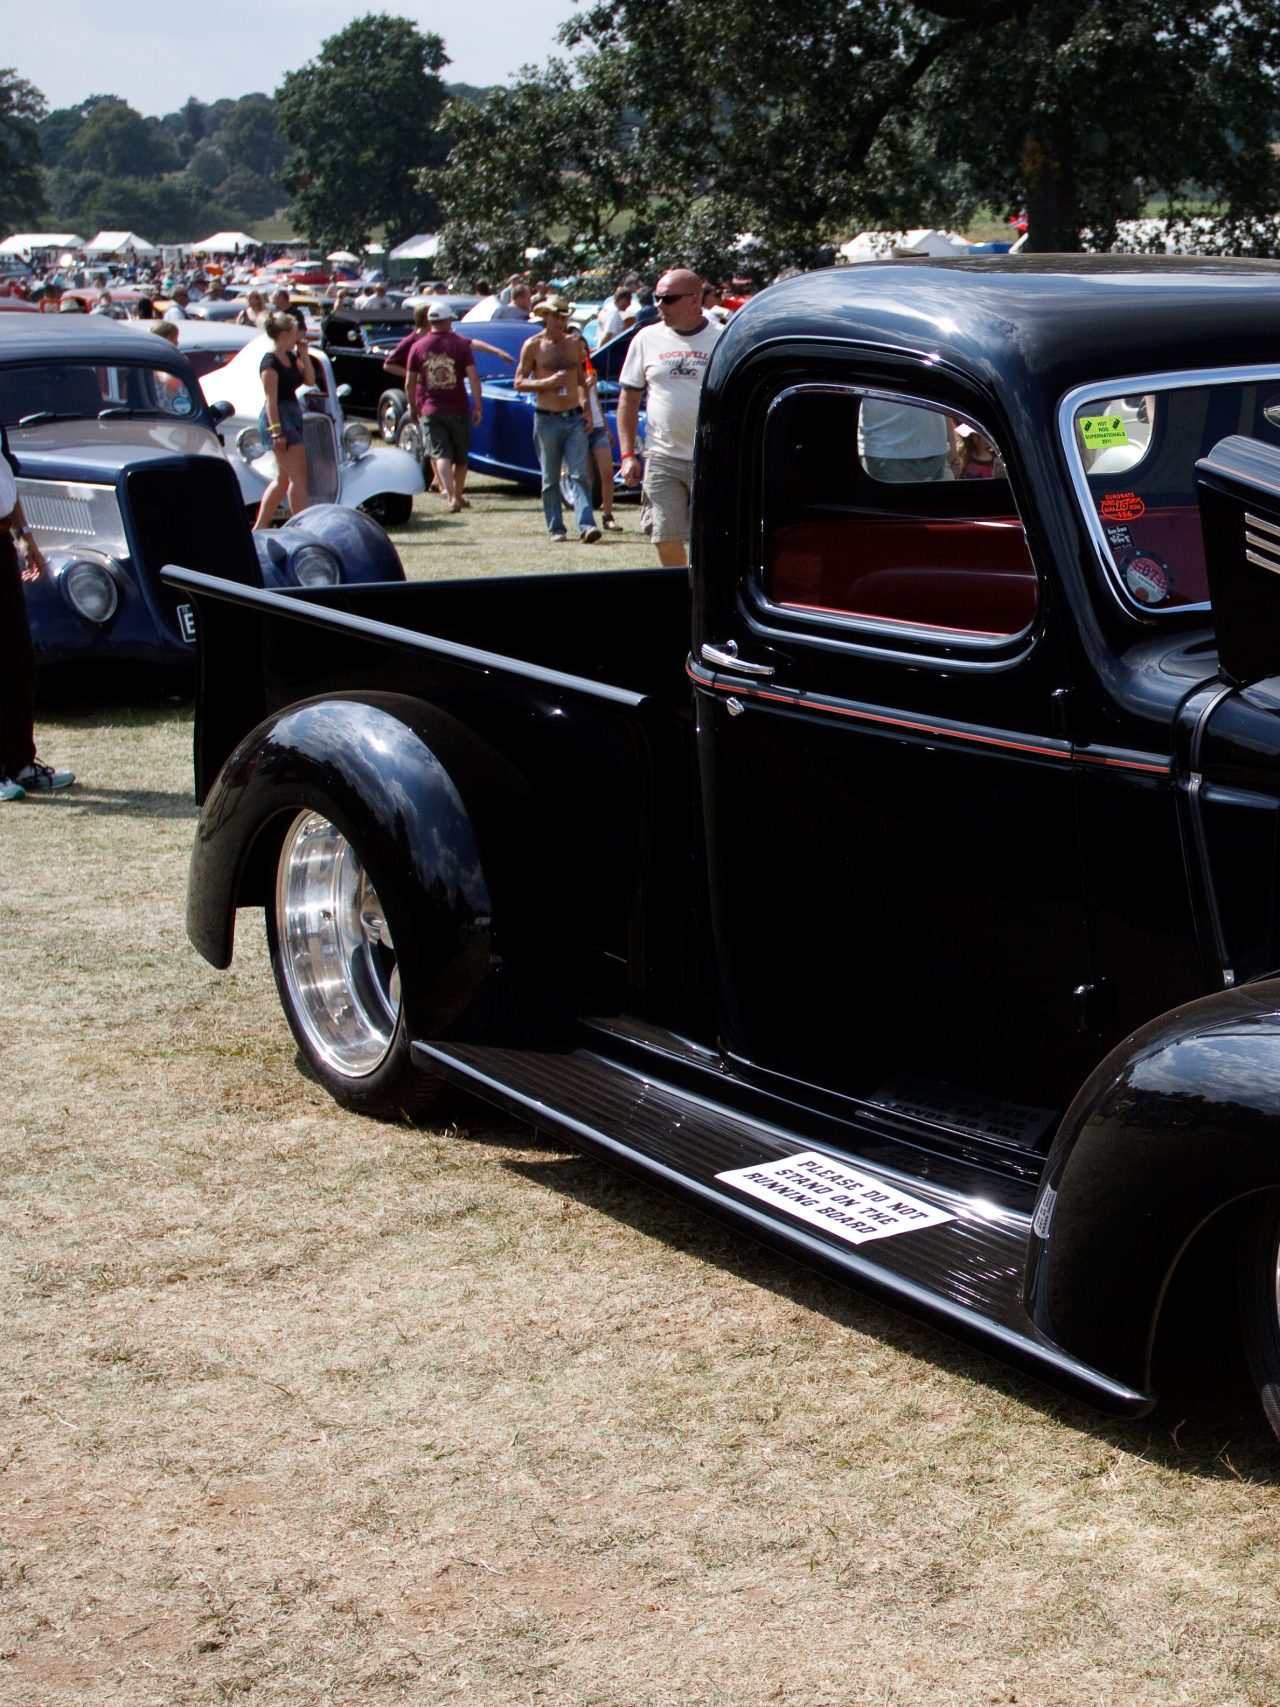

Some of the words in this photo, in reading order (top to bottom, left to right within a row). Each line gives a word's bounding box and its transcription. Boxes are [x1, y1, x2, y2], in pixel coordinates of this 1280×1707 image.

[658, 351, 709, 360] ROCKWELL
[742, 1172, 820, 1207] RUNNING
[816, 1206, 877, 1234] BOARD
[775, 1169, 833, 1196] STAND
[829, 1195, 859, 1208] ON
[859, 1207, 900, 1226] THE
[797, 1160, 864, 1191] PLEASE
[861, 1190, 889, 1204] DO
[886, 1201, 929, 1220] NOT
